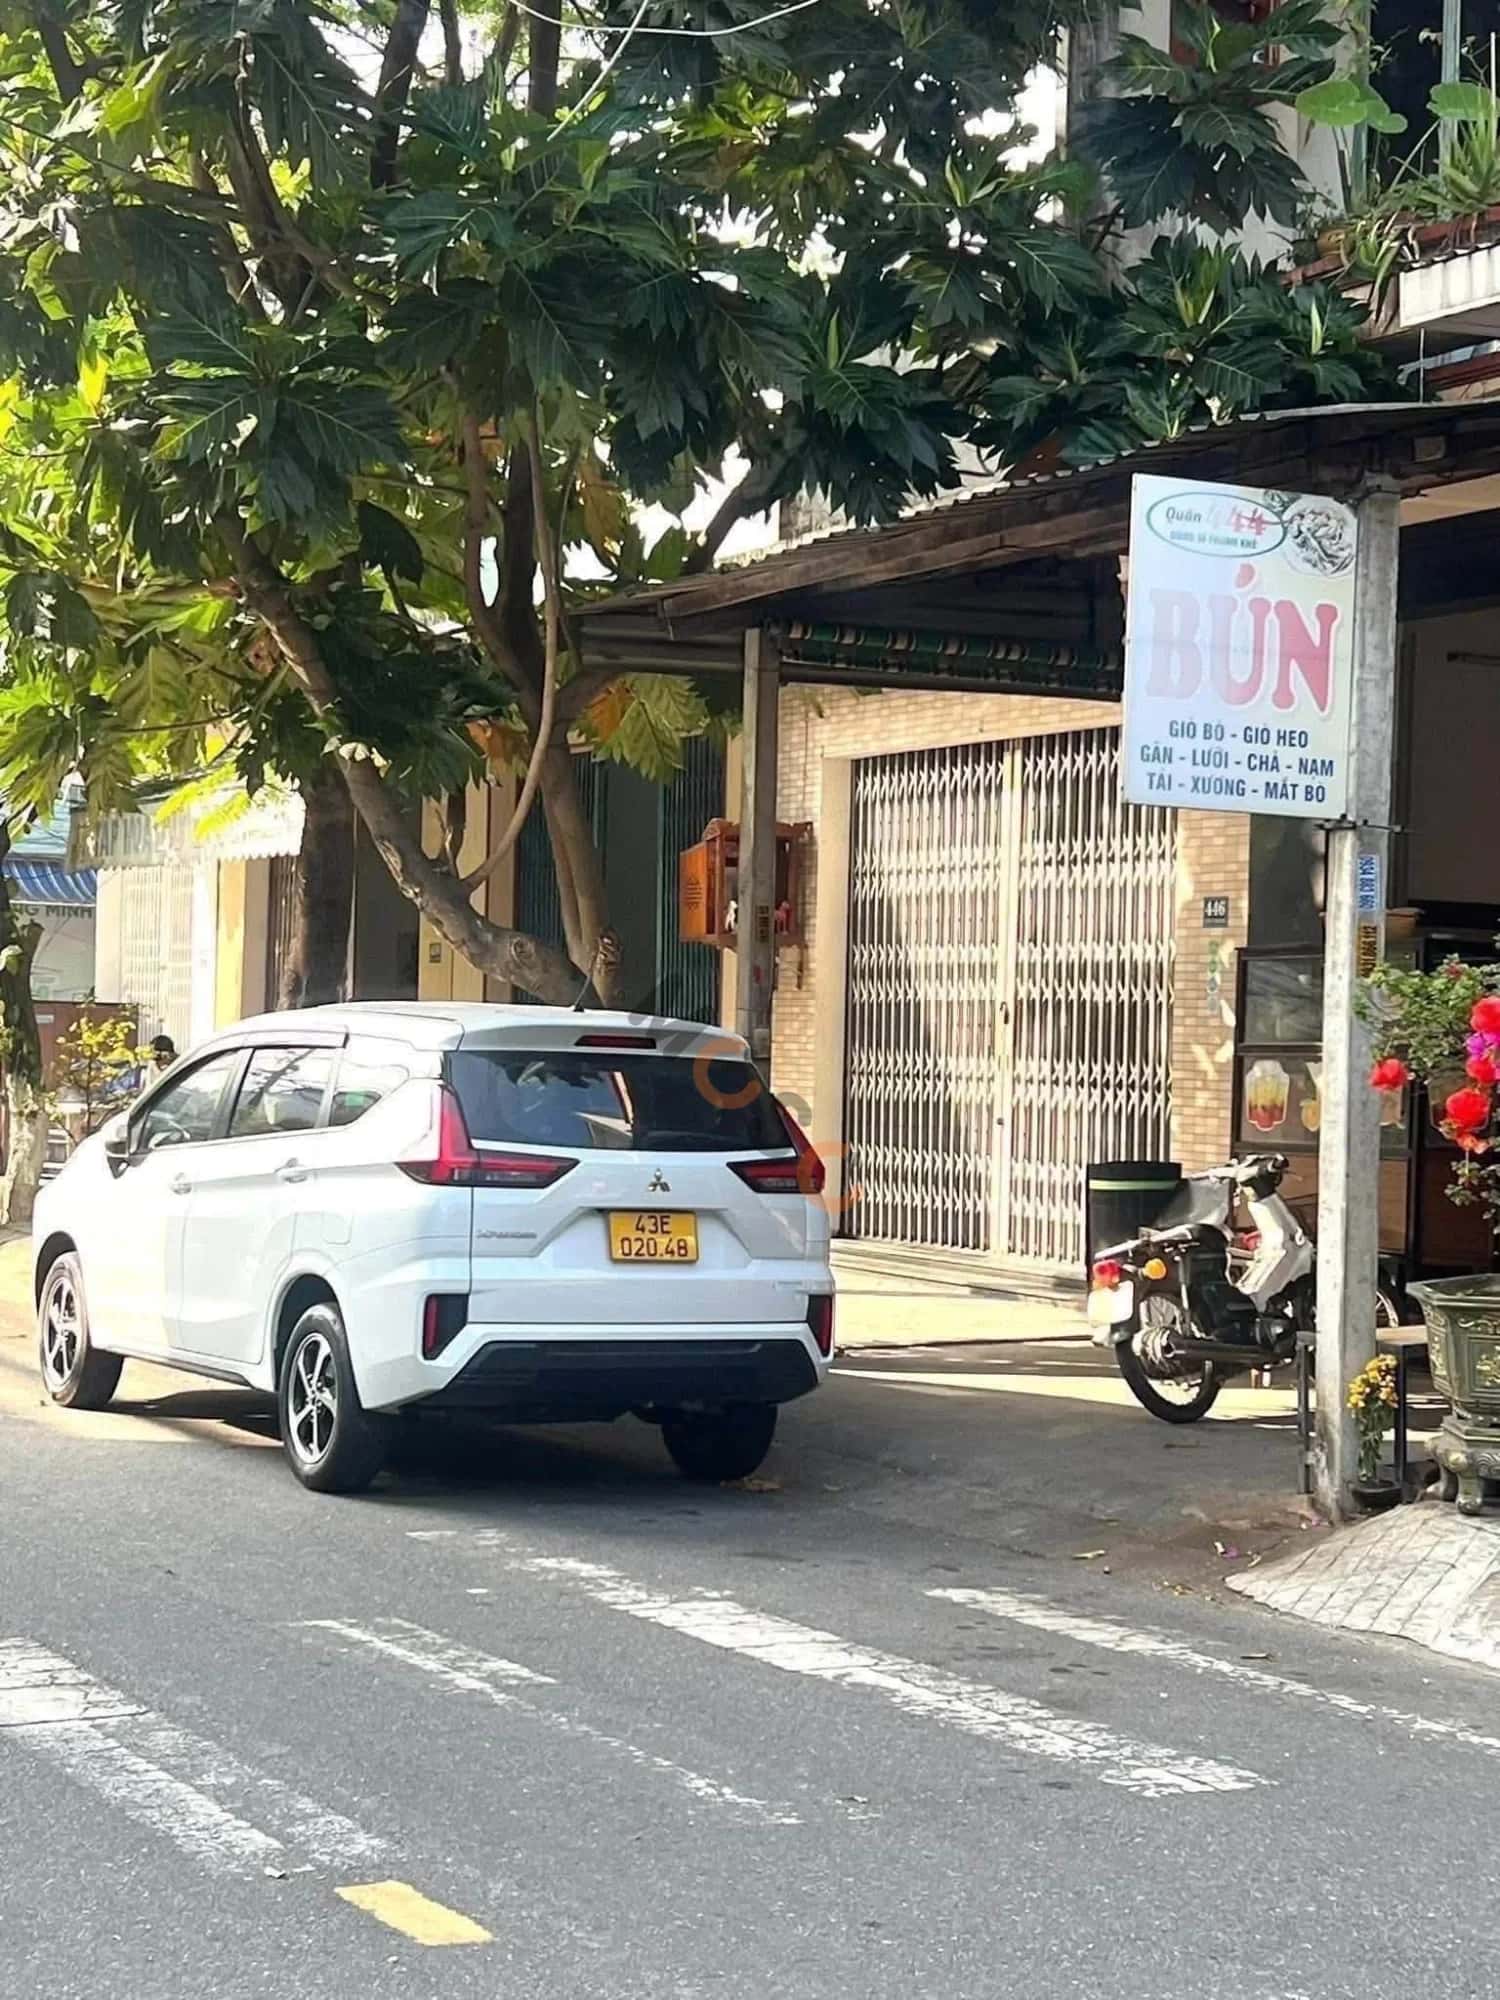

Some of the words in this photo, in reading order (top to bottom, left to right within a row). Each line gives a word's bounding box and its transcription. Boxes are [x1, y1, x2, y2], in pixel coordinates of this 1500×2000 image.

[1145, 562, 1339, 714] BÚN
[1276, 729, 1309, 749] HEO
[635, 1214, 672, 1235] 43E
[620, 1236, 689, 1258] 020.48
